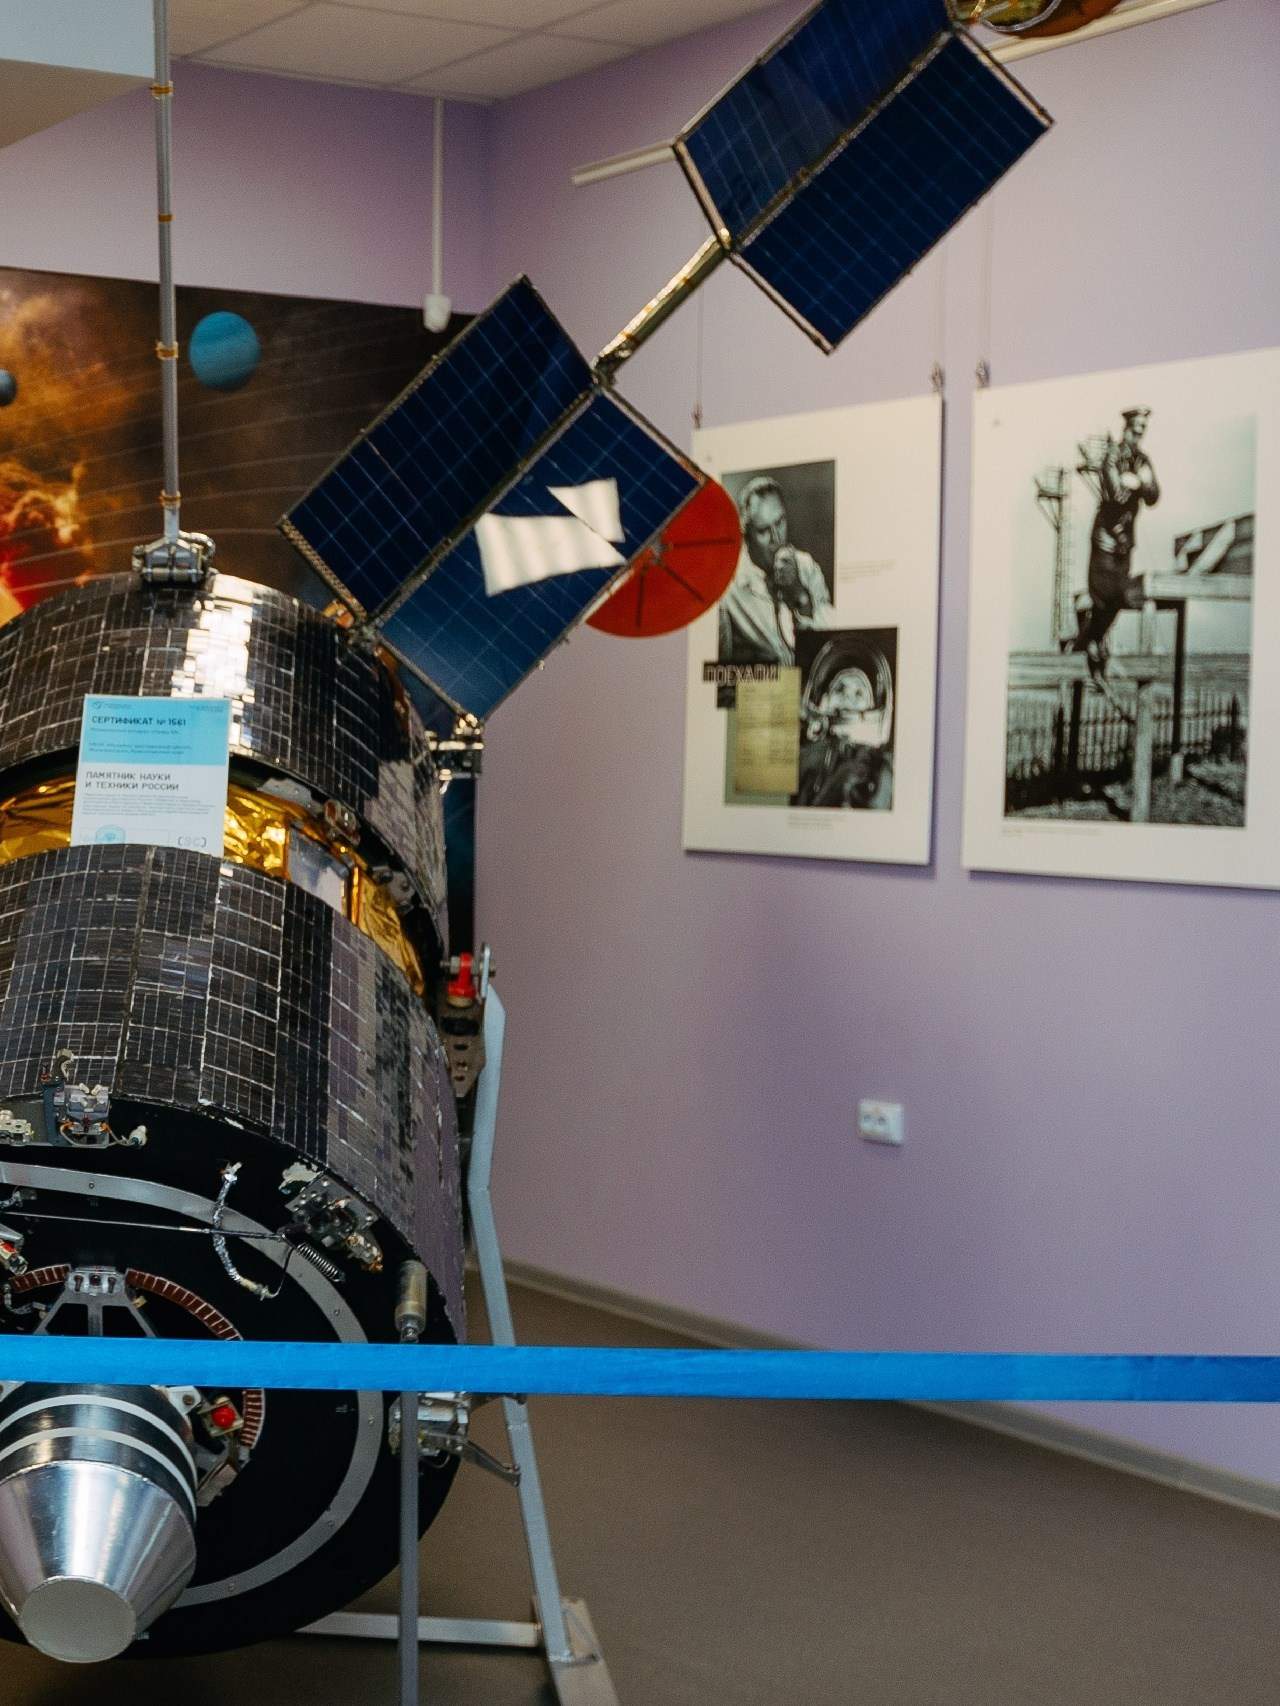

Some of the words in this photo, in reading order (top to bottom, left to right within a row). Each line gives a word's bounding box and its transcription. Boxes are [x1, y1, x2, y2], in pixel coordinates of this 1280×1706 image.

[92, 715, 153, 726] СЕРТИФИКАТ
[86, 771, 136, 780] ПАМЯТНИК
[140, 772, 171, 781] НАУКИ
[96, 782, 139, 790] ТЕХНИКИ
[142, 783, 179, 791] РОССИИ
